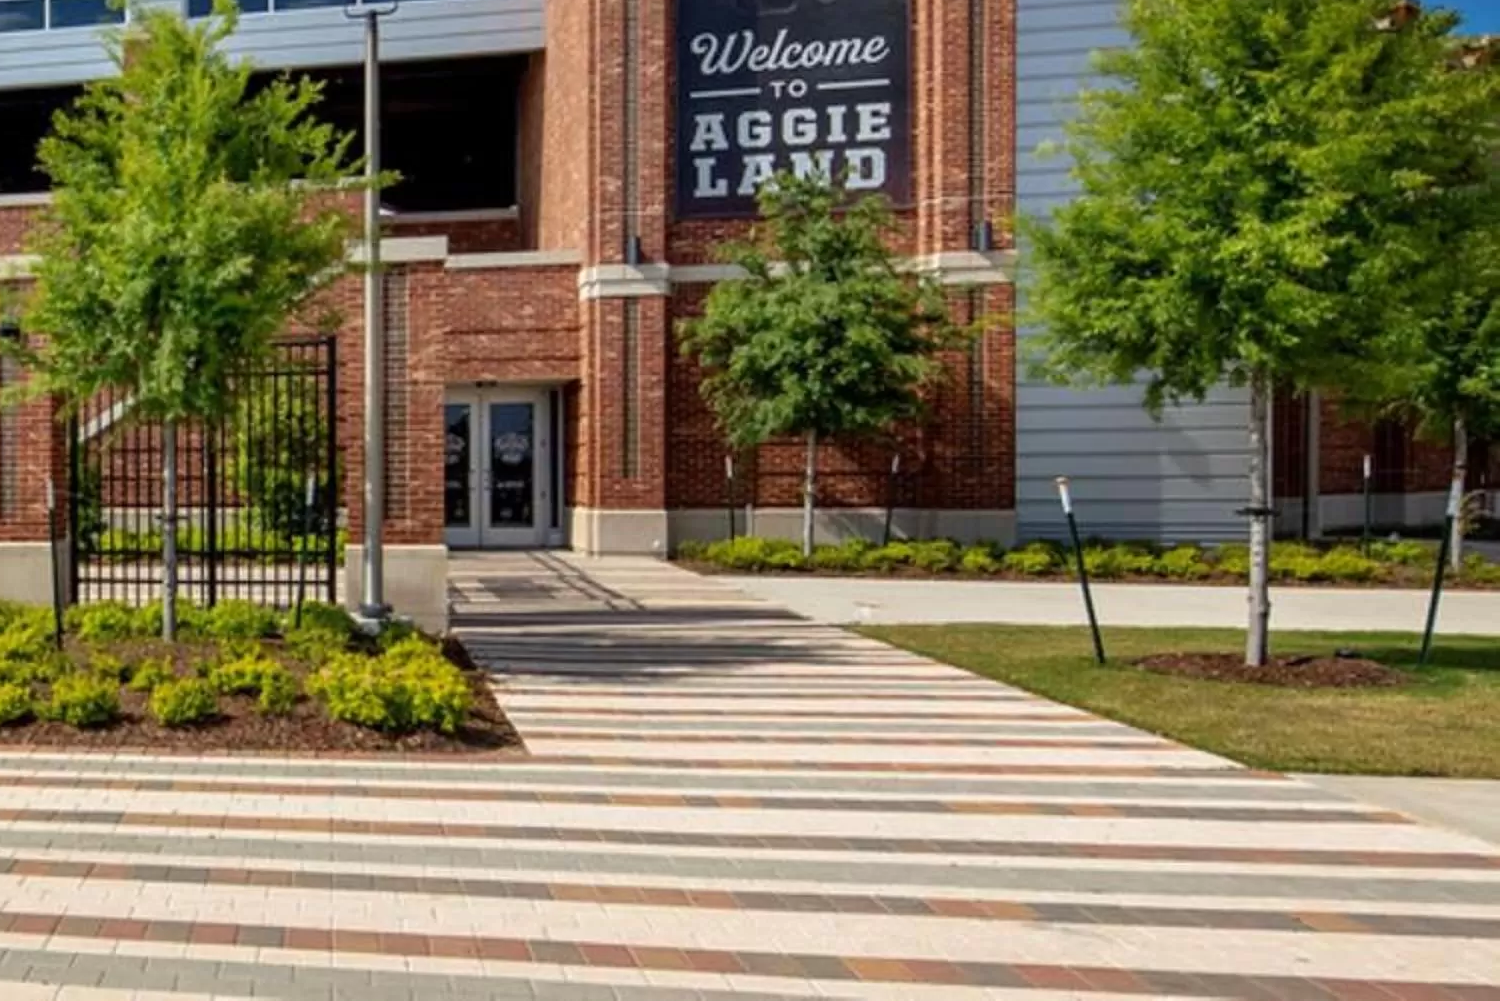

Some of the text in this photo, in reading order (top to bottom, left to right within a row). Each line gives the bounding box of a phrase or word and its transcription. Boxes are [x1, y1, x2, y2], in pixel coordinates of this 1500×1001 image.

[691, 28, 890, 75] Welcome
[770, 79, 808, 99] TO
[690, 102, 891, 151] AGGIE
[693, 147, 886, 198] LAND
